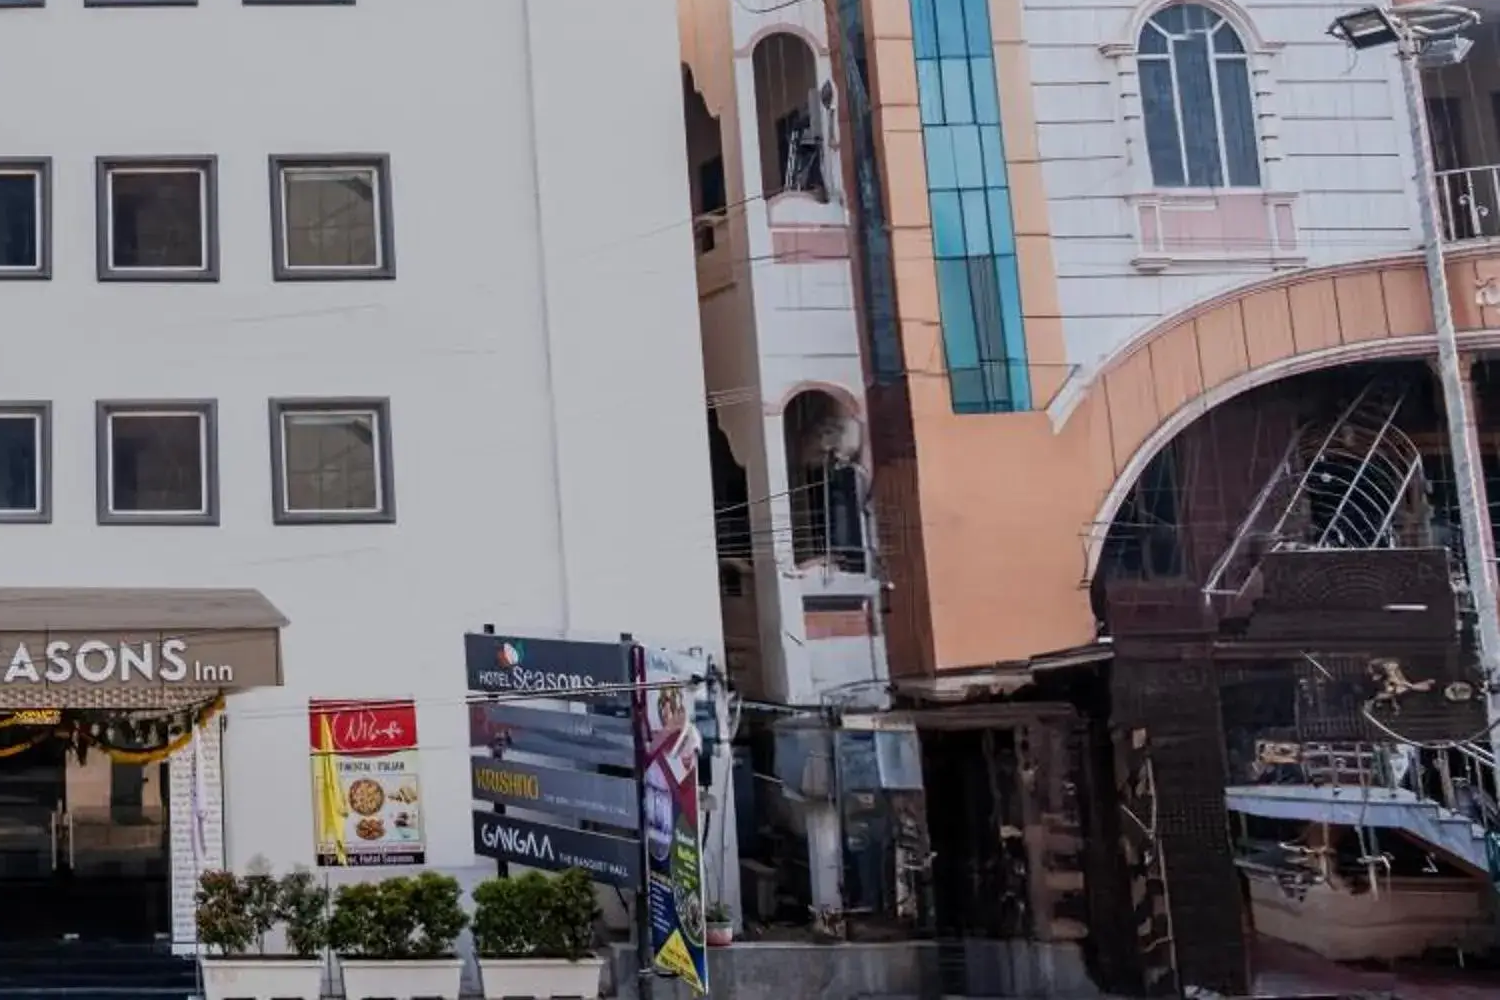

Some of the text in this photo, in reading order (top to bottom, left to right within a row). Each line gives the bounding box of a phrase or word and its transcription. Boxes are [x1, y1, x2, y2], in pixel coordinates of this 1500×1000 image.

[195, 659, 234, 682] Inn
[479, 664, 595, 692] HOTEL Seasons
[481, 823, 555, 860] GANGAA
